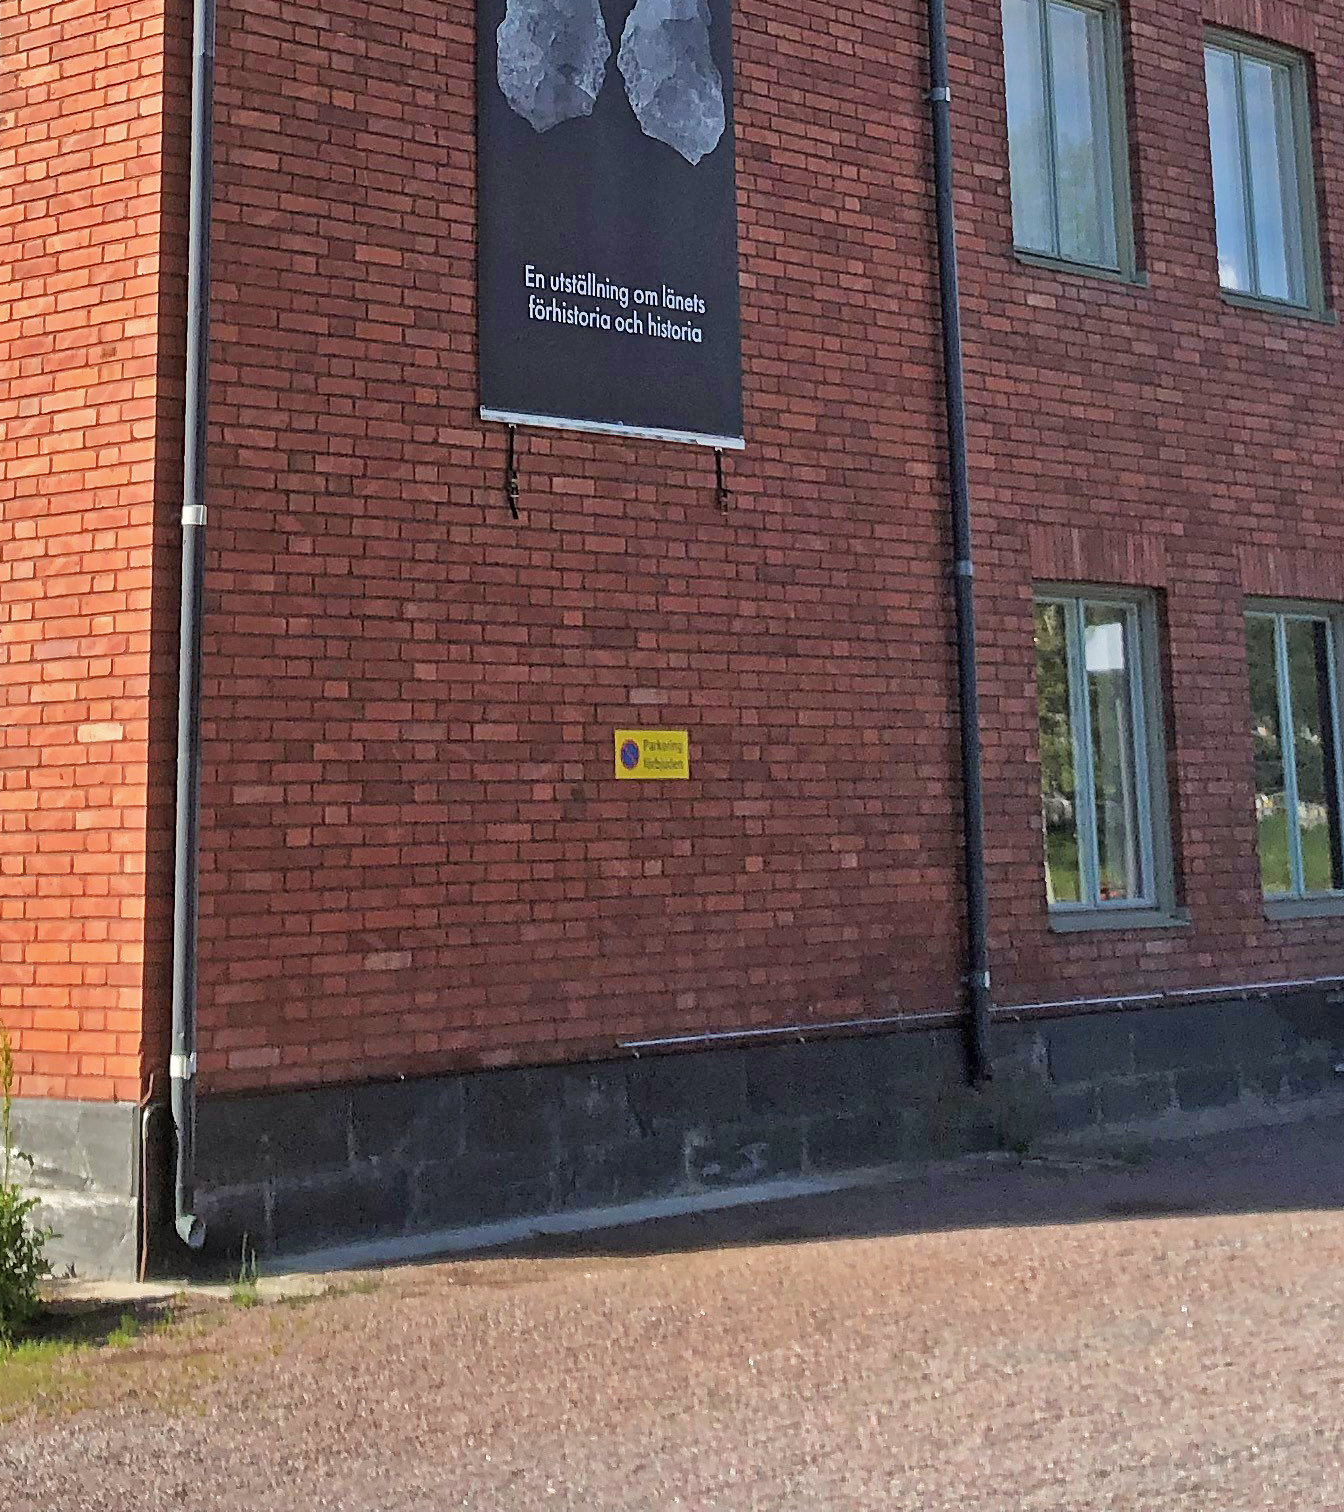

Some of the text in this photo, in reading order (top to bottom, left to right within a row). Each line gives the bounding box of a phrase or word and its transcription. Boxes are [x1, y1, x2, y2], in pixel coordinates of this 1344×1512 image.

[525, 264, 706, 315] En utställning om länets
[528, 294, 703, 343] förhistoria och historia
